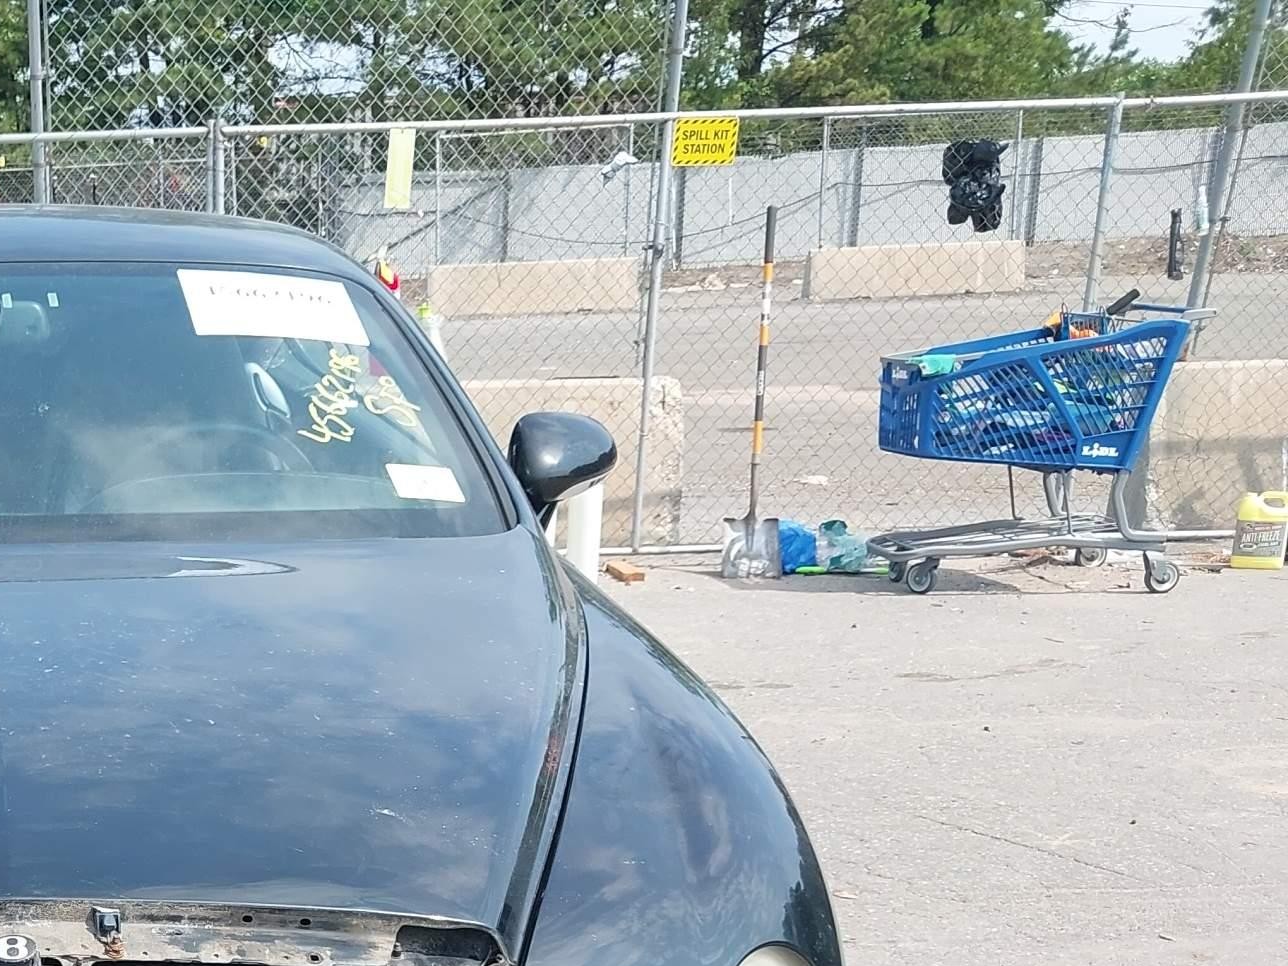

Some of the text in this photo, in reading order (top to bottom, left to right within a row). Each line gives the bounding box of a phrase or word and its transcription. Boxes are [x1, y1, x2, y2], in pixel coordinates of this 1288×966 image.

[682, 129, 731, 141] SPILL KIT
[682, 143, 726, 154] STATION
